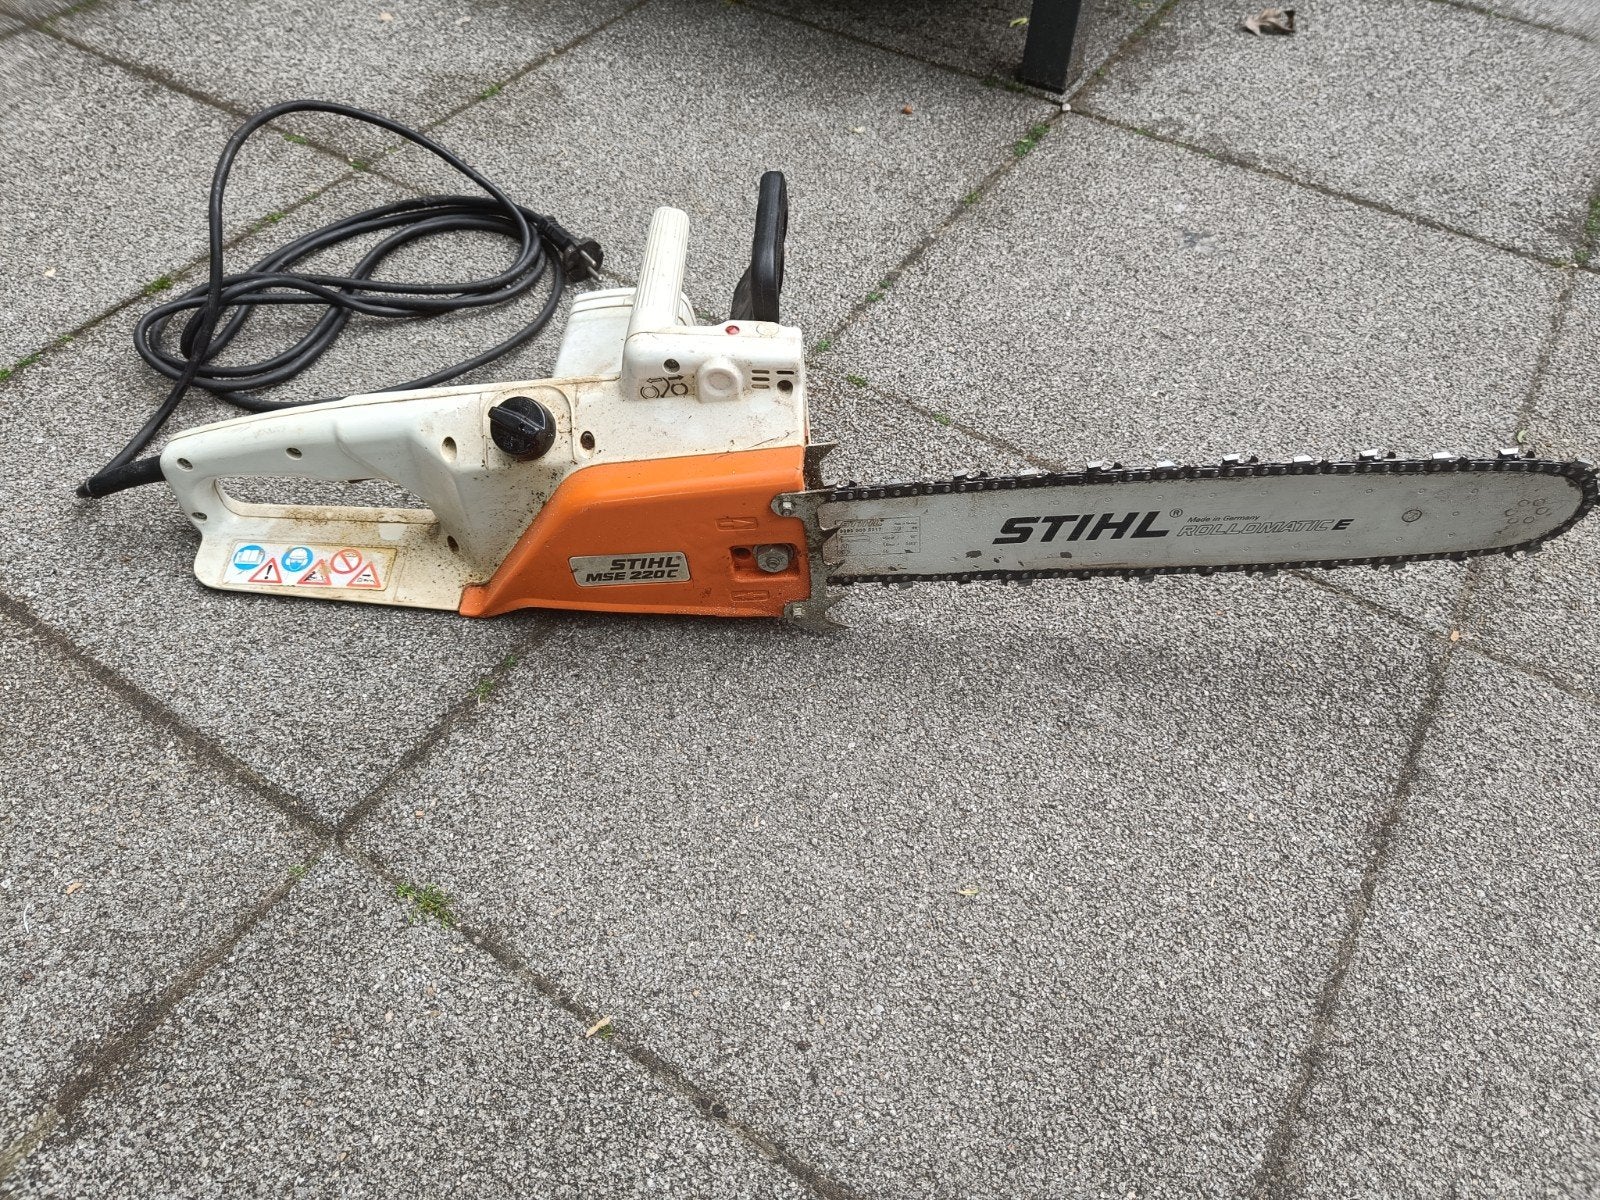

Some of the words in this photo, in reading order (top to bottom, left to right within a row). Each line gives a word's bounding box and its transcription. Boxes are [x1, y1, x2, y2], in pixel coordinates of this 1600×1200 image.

[1223, 515, 1260, 523] Germany
[1177, 519, 1335, 537] ROLLOMATIC
[586, 572, 626, 582] MSE
